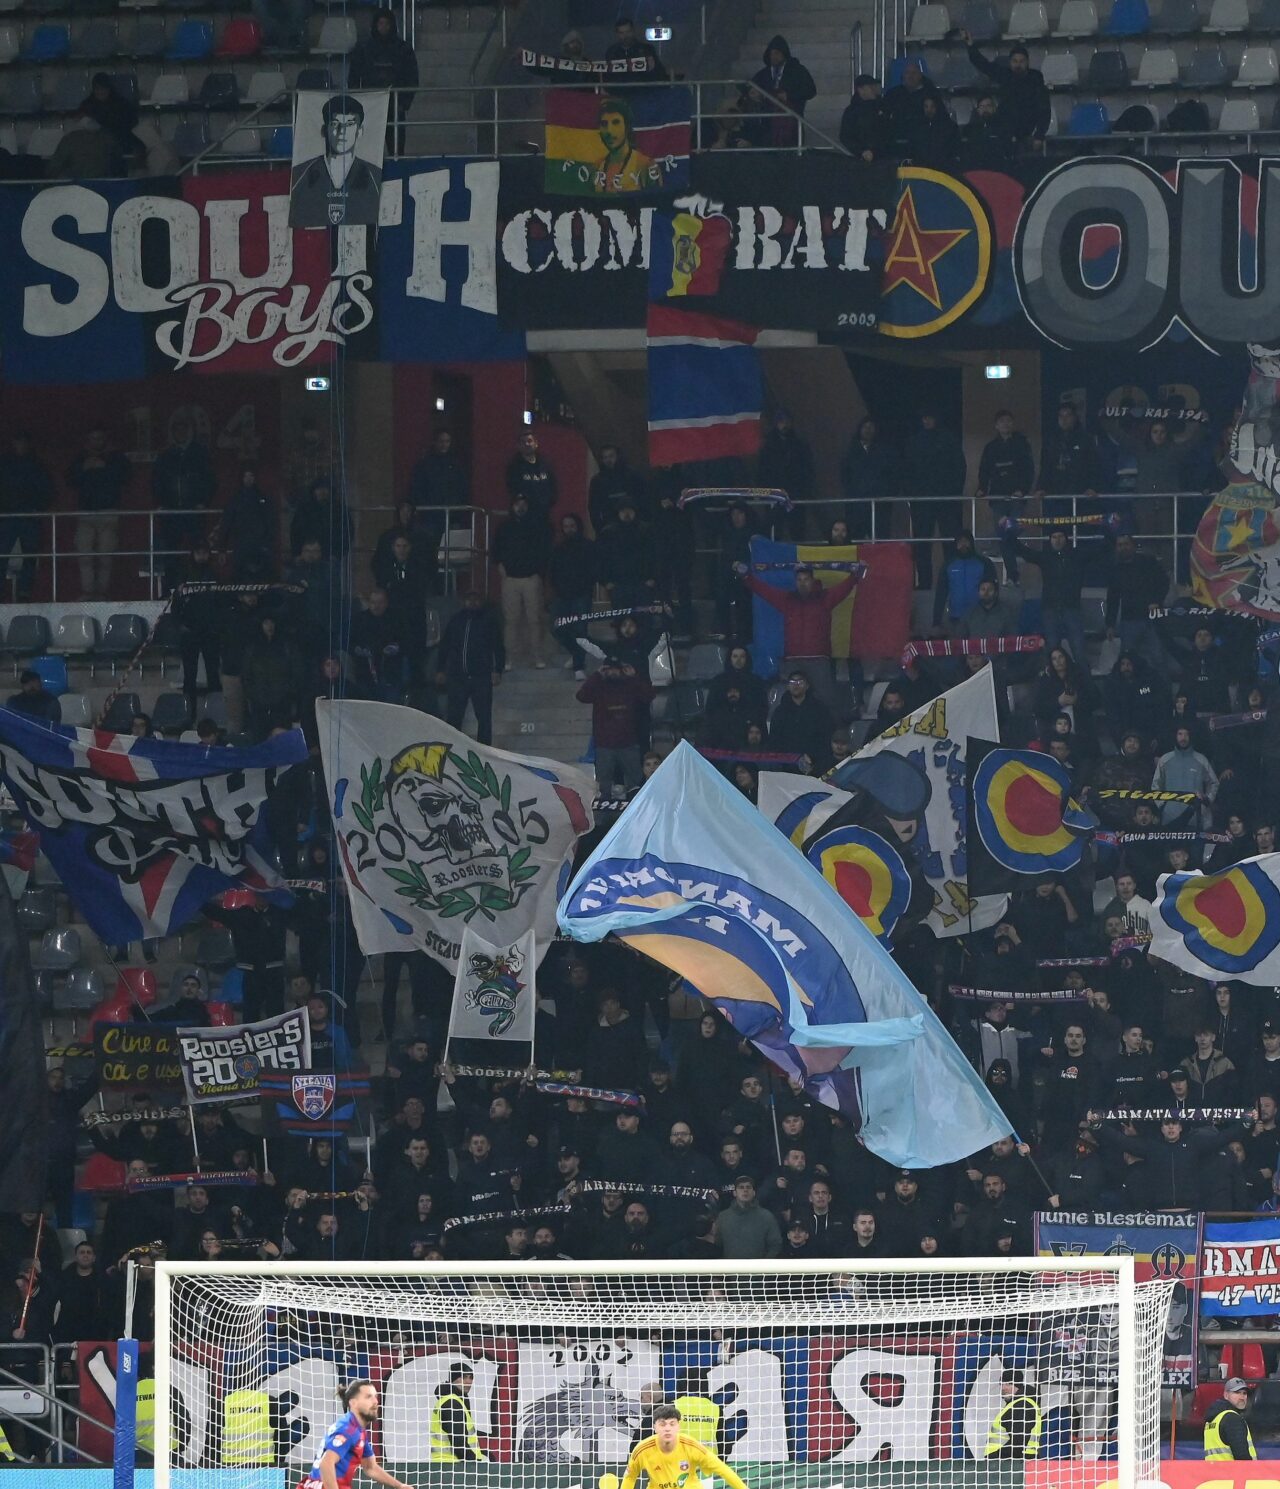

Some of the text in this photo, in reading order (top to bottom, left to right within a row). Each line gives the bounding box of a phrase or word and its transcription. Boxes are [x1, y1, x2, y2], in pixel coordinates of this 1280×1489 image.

[562, 153, 678, 190] FOREVER
[156, 273, 373, 370] Boys
[346, 797, 549, 872] 20 05
[1147, 831, 1197, 842] BUCURESTI
[103, 1028, 151, 1055] Cine
[294, 1075, 337, 1090] STEAUA
[1106, 1107, 1245, 1120] ARMATA 47 VEST
[582, 1180, 645, 1193] ARMATA
[672, 1185, 714, 1200] VEST
[1218, 1285, 1244, 1307] 47
